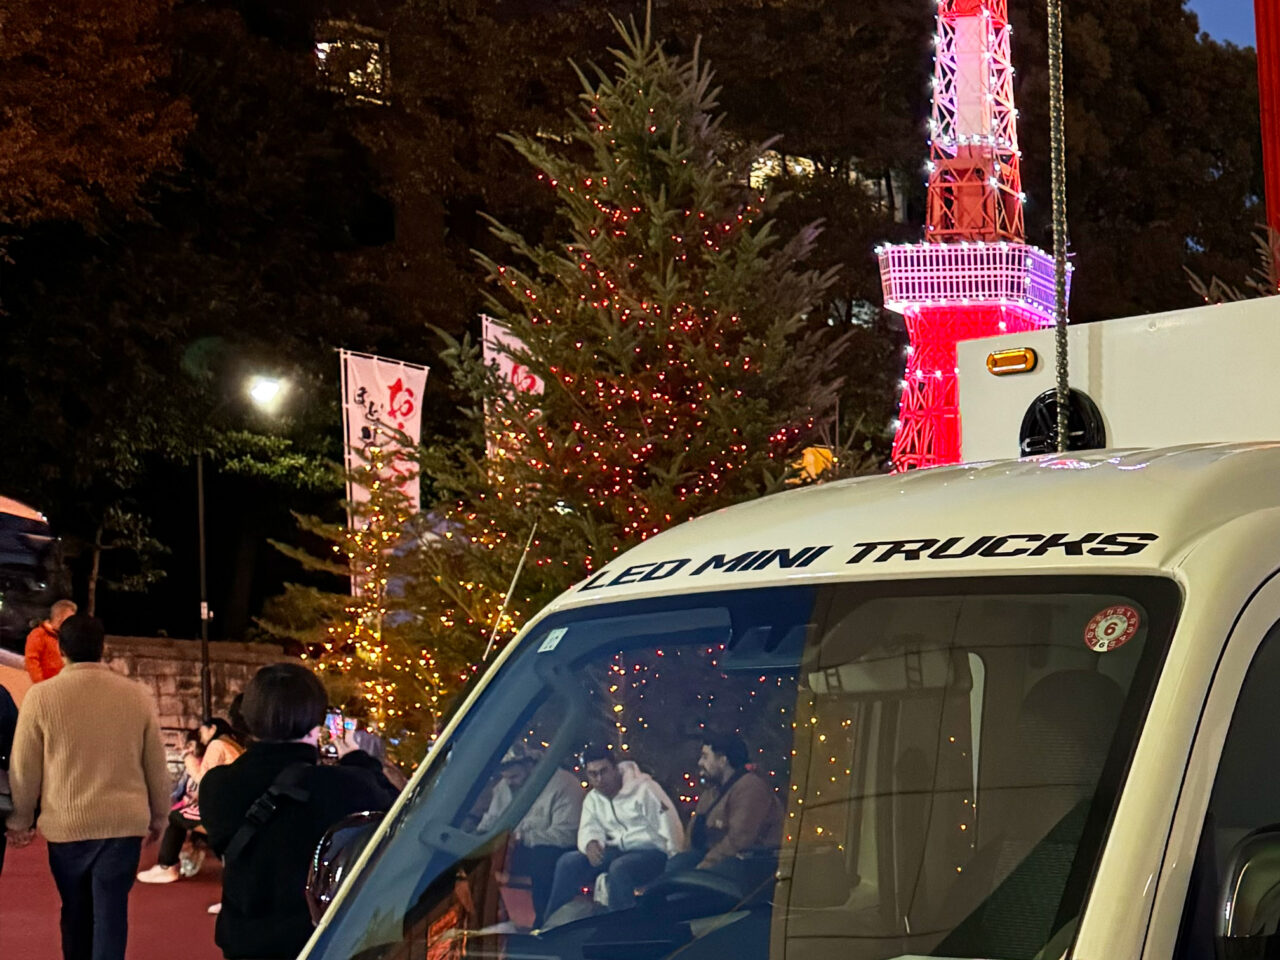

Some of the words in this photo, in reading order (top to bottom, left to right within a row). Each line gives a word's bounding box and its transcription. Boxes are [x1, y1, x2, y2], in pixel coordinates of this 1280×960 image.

[577, 558, 692, 592] LED
[690, 545, 835, 577] MINI
[845, 532, 1160, 565] TRUCKS
[1104, 622, 1118, 636] 6
